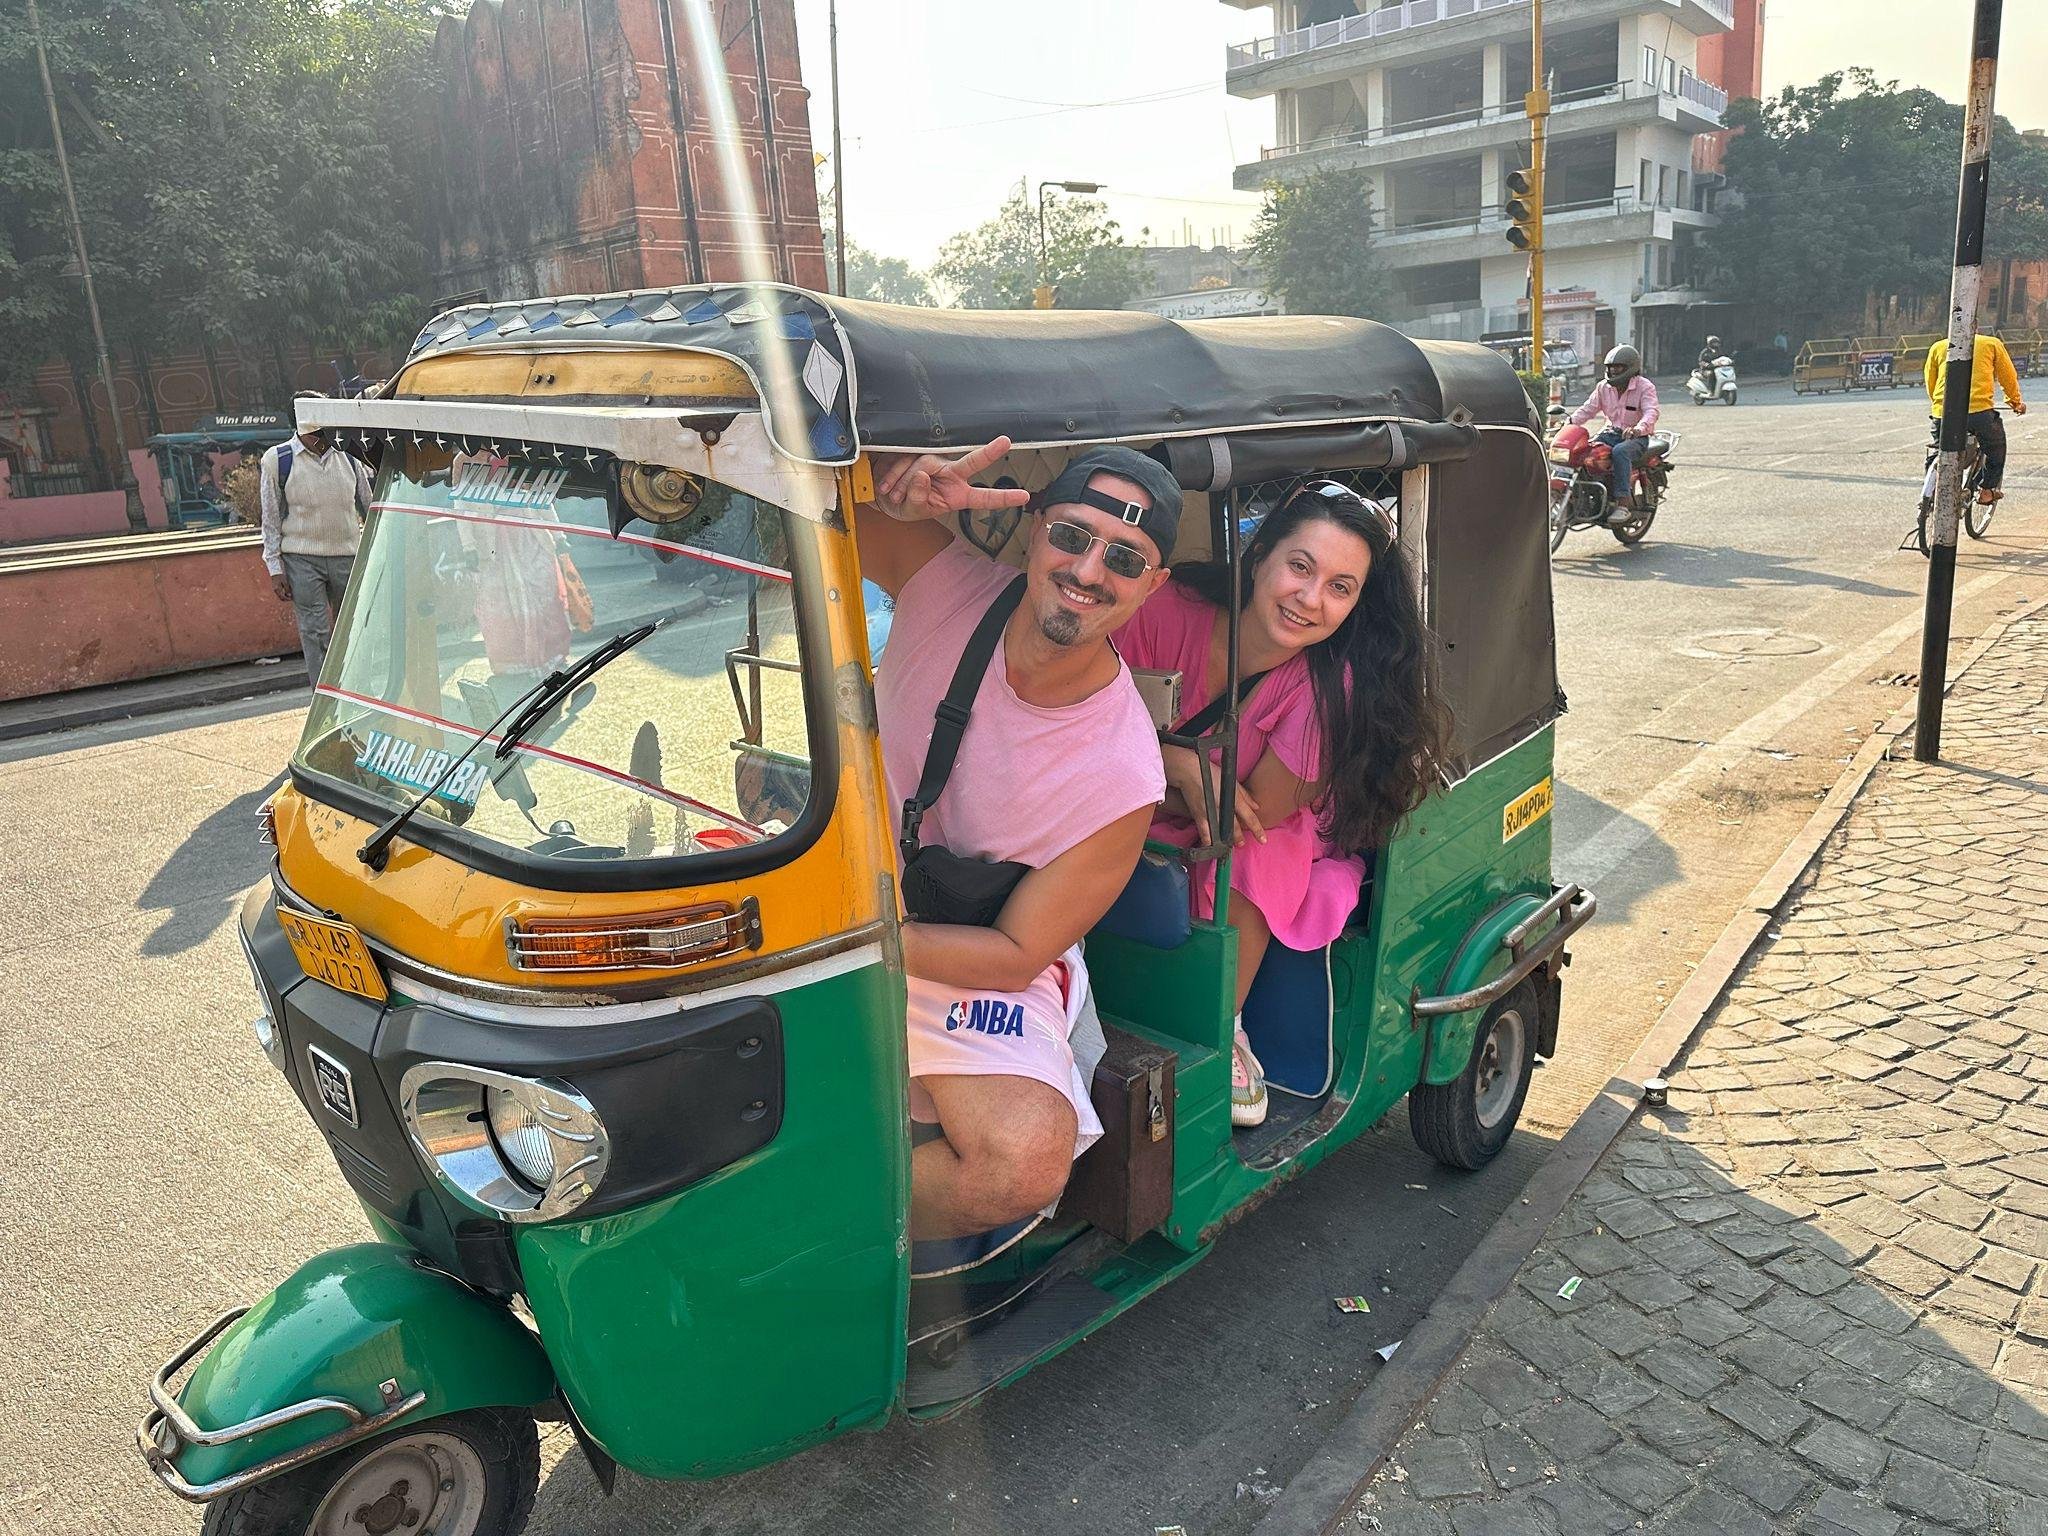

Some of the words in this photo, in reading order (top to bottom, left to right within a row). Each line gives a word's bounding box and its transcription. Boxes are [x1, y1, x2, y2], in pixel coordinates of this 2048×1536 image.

[1860, 363, 1890, 376] JKJ
[242, 415, 277, 424] Metro
[294, 919, 351, 960] RJ14P
[966, 1000, 1025, 1037] NBA
[318, 1069, 351, 1113] RE
